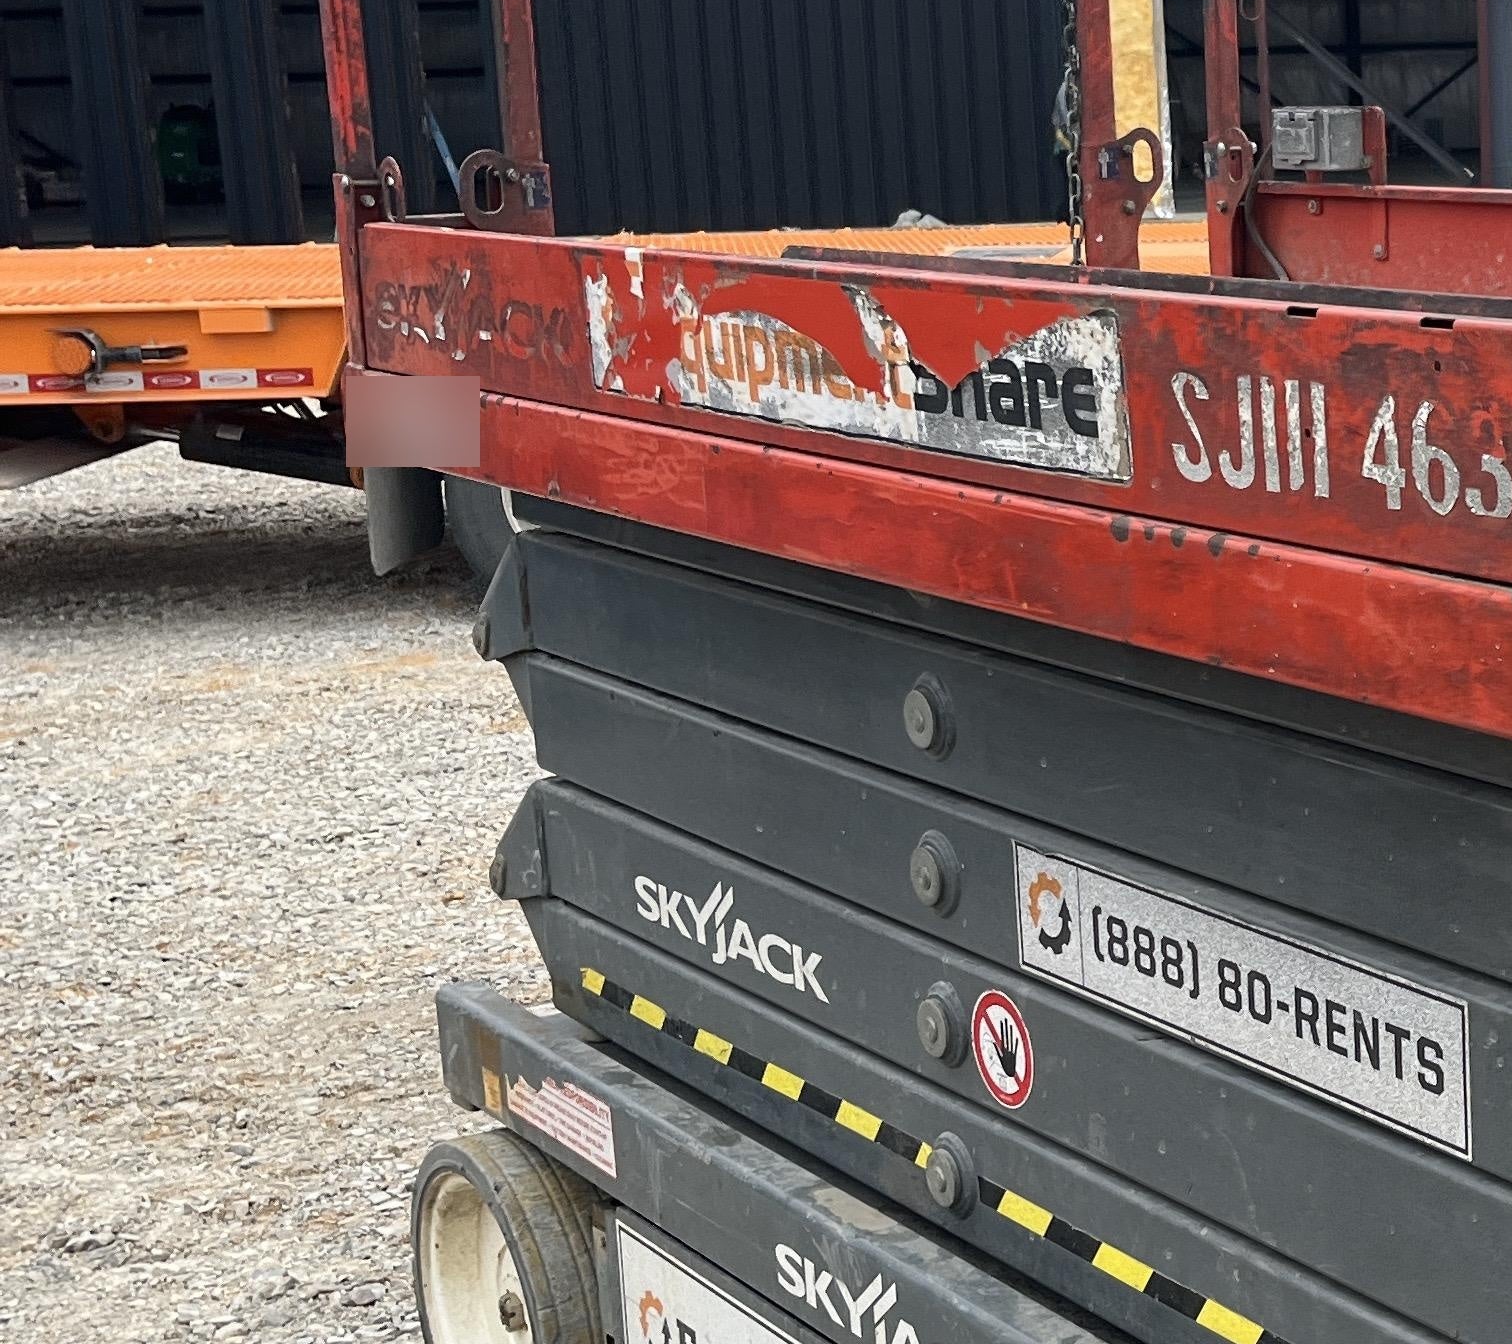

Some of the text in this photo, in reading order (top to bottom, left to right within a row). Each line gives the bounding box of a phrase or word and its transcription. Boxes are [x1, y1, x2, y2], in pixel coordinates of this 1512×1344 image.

[633, 874, 831, 1005] SKYJACK
[1091, 905, 1445, 1096] (888) 80-RENTS
